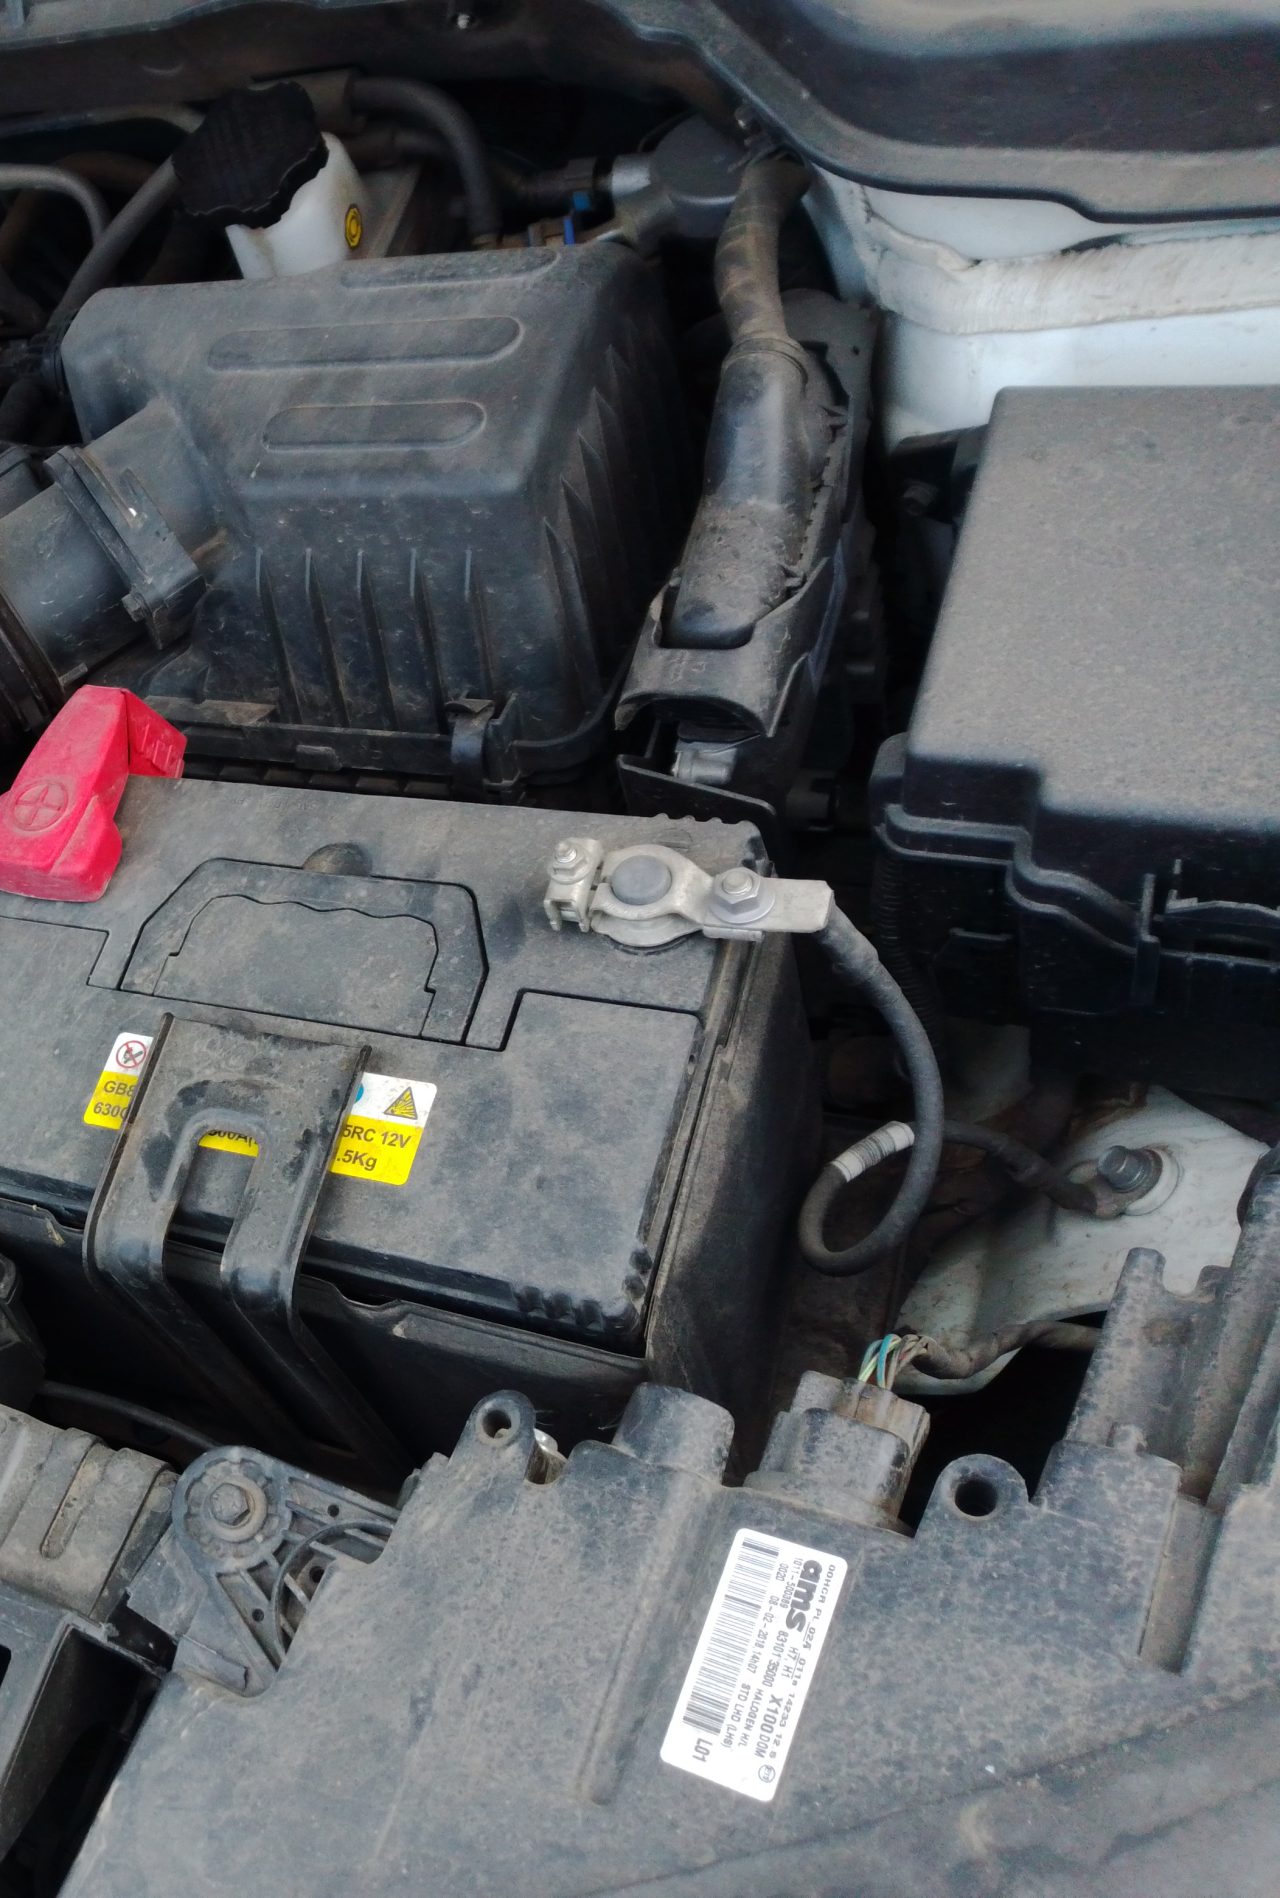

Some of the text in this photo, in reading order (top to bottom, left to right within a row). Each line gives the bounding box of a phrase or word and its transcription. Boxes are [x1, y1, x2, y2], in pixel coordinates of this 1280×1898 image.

[381, 1131, 411, 1148] 12V
[775, 1562, 789, 1582] 0020
[785, 1559, 823, 1633] ams
[812, 1607, 823, 1620] PL
[761, 1630, 789, 1688] 83101 35000
[781, 1664, 794, 1679] H1
[720, 1683, 751, 1748] STD LHD (LHS)
[737, 1688, 764, 1747] HALOGEN H/L
[754, 1694, 784, 1759] X100 DOM
[779, 1693, 796, 1728] 14233
[692, 1737, 713, 1763] L01
